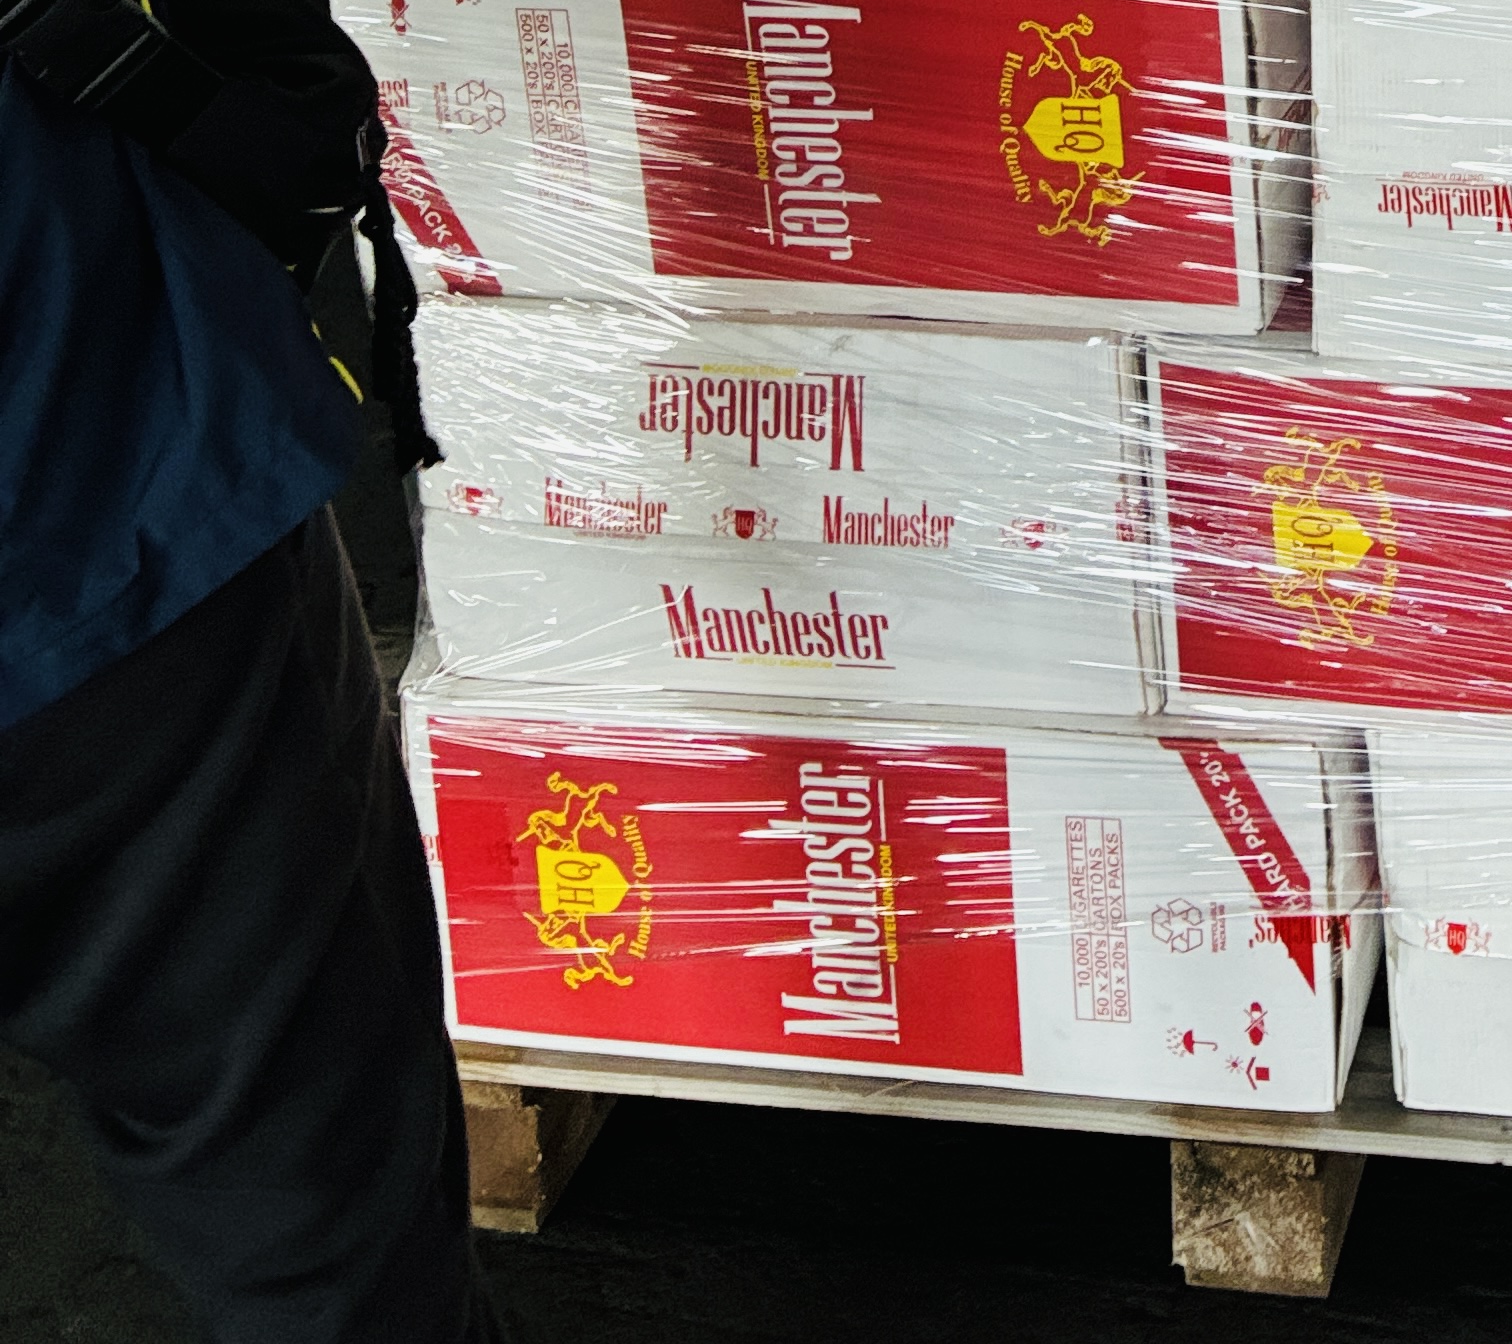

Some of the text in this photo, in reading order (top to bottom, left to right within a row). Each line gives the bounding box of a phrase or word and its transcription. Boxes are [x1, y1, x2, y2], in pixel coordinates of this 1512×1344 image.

[519, 13, 546, 135] 500 x 20's BOX
[536, 13, 556, 91] 50 x 200's
[556, 42, 575, 92] 10,000
[747, 61, 770, 182] UNITED KINGDOM
[998, 51, 1035, 204] House of Quality
[1053, 103, 1105, 155] HQ
[638, 372, 867, 473] Manchester
[822, 495, 955, 550] Manchester
[659, 583, 890, 662] Manchester
[1218, 784, 1267, 852] PACK
[553, 858, 602, 909] HQ
[621, 815, 654, 960] House Quality
[1106, 832, 1121, 889] PACKS
[1257, 849, 1305, 913] HARD
[767, 762, 901, 1045] Manchester
[879, 843, 899, 963] UNITED KINGDOM
[1089, 847, 1110, 1017] 50 x 200's CARTONS
[1075, 937, 1093, 988] 10,000
[1111, 941, 1127, 970] 20's
[1449, 929, 1466, 947] HQ
[1114, 989, 1128, 1018] 500
[1116, 975, 1126, 984] x
